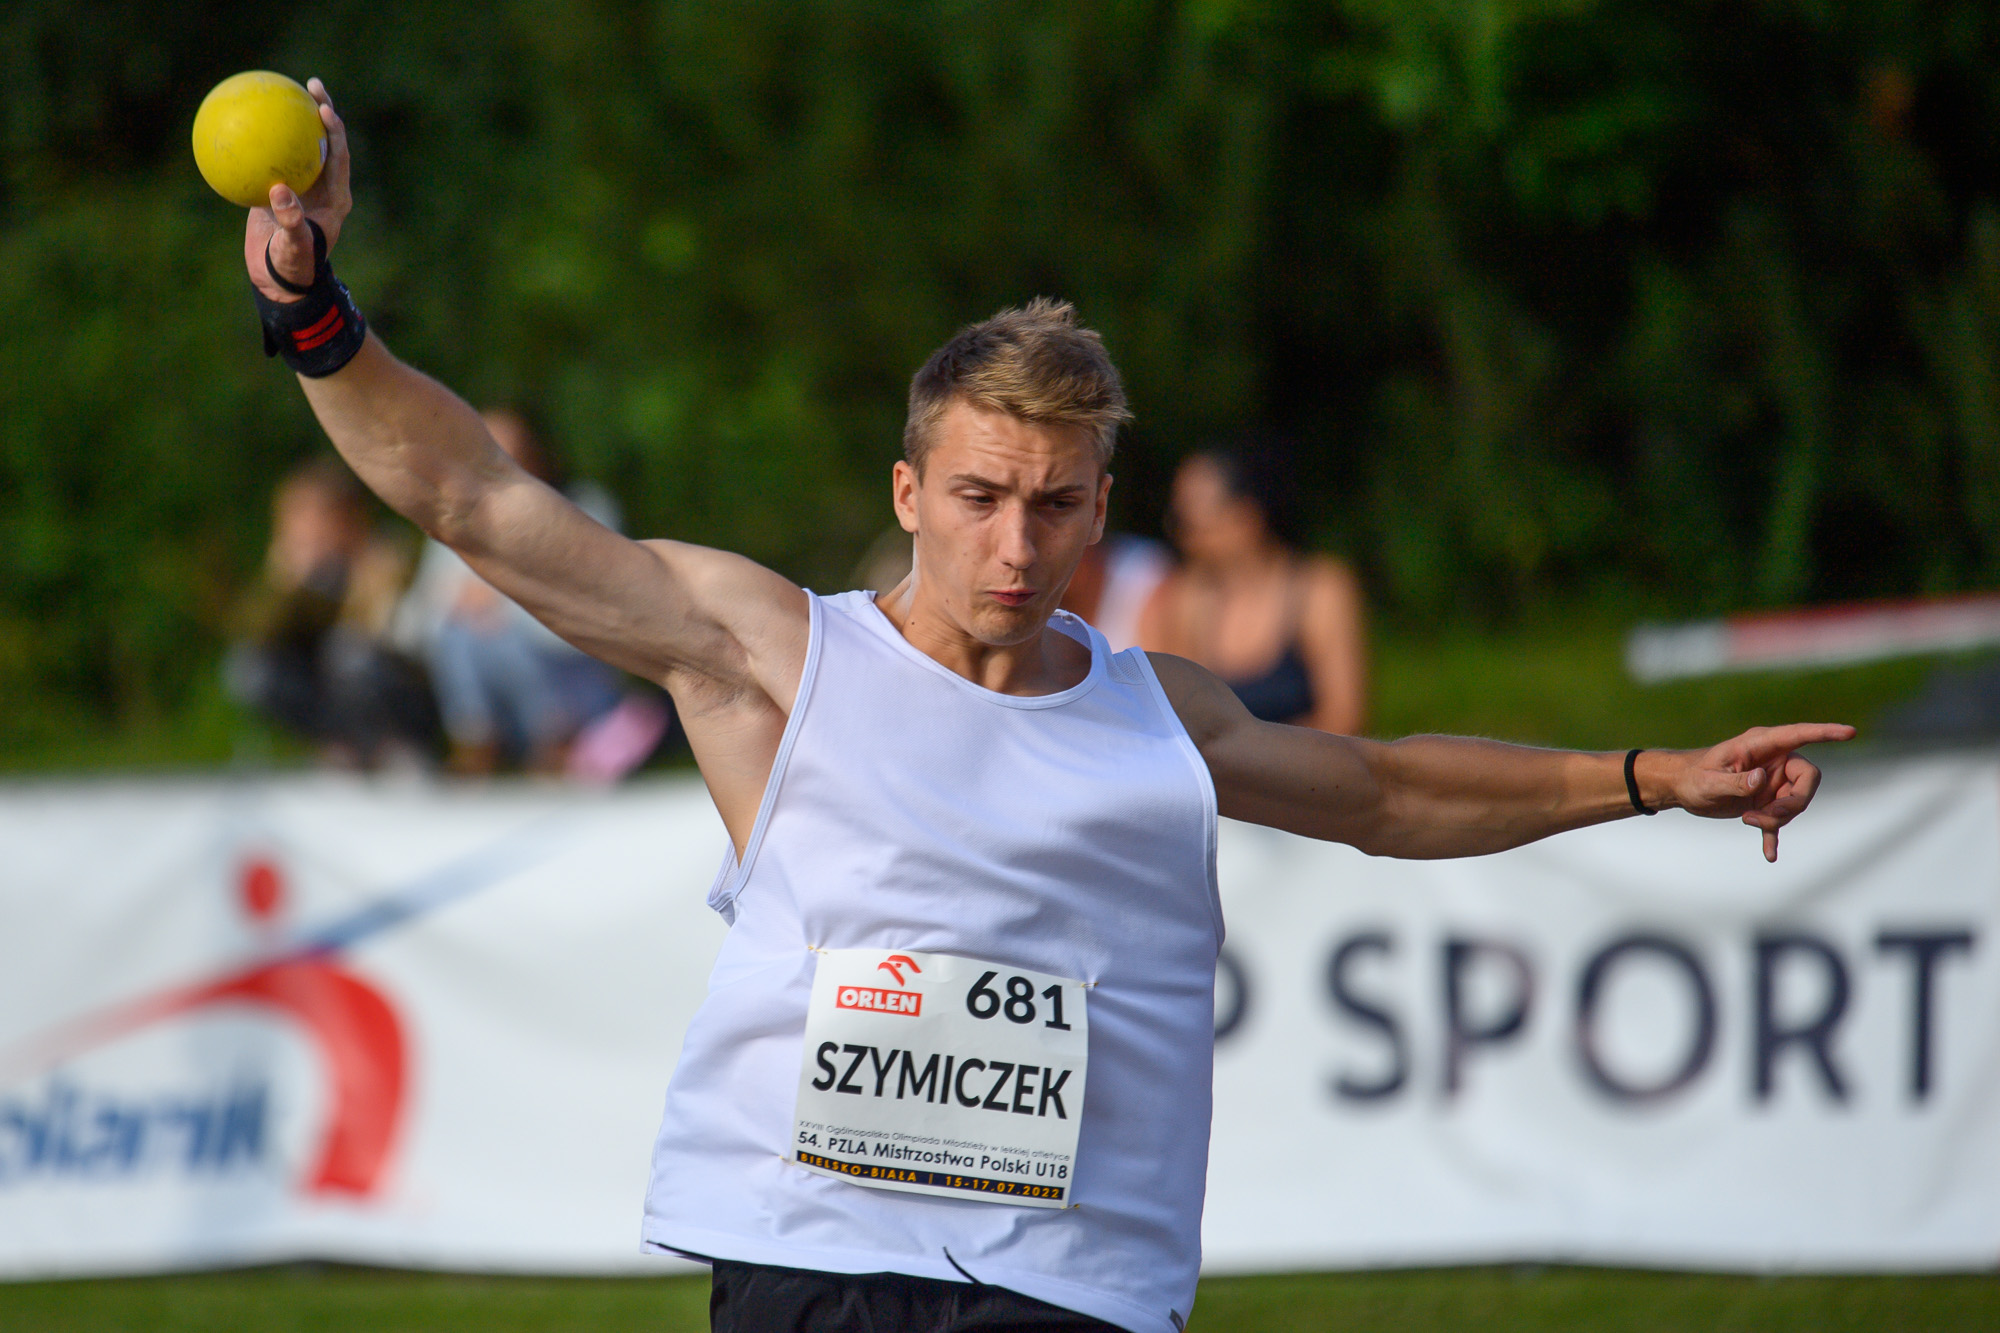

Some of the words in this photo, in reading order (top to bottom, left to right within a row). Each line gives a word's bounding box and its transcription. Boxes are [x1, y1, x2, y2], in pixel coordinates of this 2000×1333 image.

[839, 989, 917, 1014] ORLEN
[966, 971, 1072, 1031] 681
[1322, 927, 1976, 1109] SPORT
[812, 1041, 1073, 1119] SZYMICZEK
[798, 1131, 822, 1148] 54.
[828, 1137, 867, 1155] PZLA
[873, 1142, 974, 1168] Mistrzostwa
[980, 1155, 1030, 1175] Polski
[1035, 1162, 1068, 1179] U18
[892, 1132, 940, 1145] Olimpiada
[800, 1153, 917, 1182] BIELSKO-BIAŁA
[945, 1176, 1060, 1199] 15-17.07.2022
